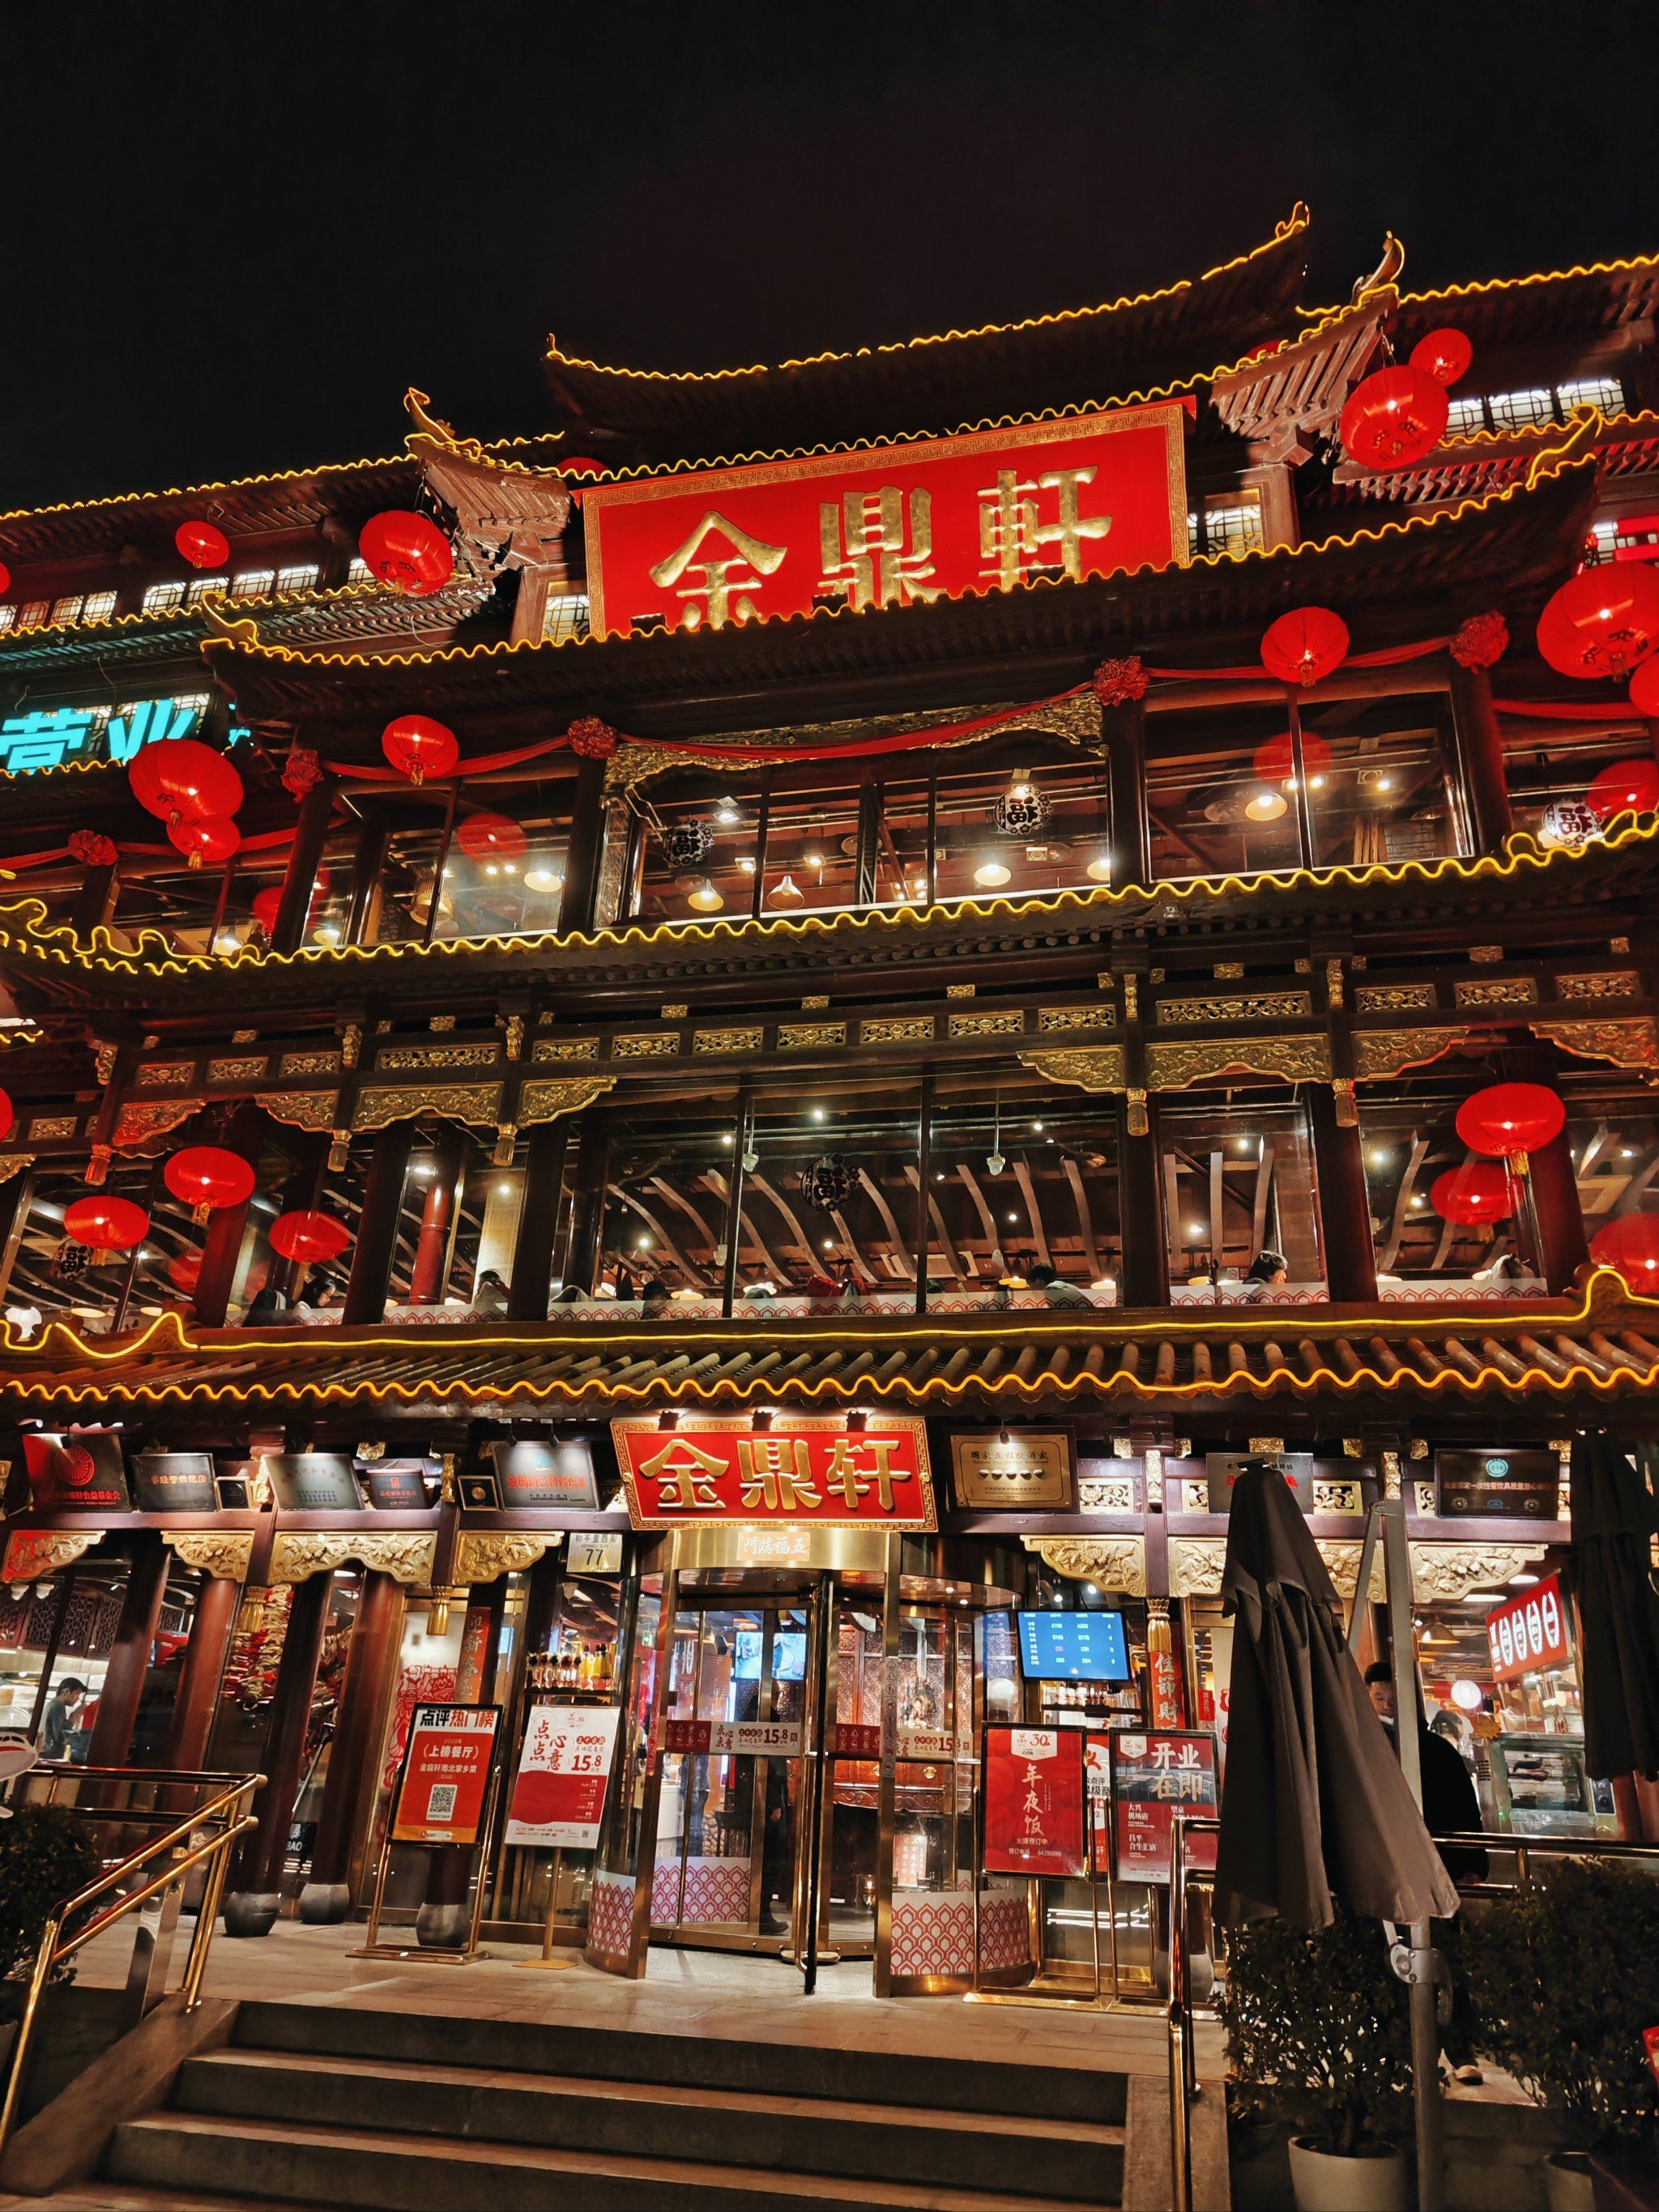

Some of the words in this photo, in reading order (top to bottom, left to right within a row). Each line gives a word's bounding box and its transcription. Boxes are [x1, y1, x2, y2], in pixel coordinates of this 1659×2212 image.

[0, 699, 250, 769] 营业
[586, 1549, 603, 1566] 77
[420, 1709, 495, 1728] 点评热门榜
[570, 1754, 602, 1771] 15.8
[1150, 1741, 1201, 1771] 开业
[1021, 1762, 1044, 1837] 年夜饭
[1150, 1769, 1203, 1802] 在即
